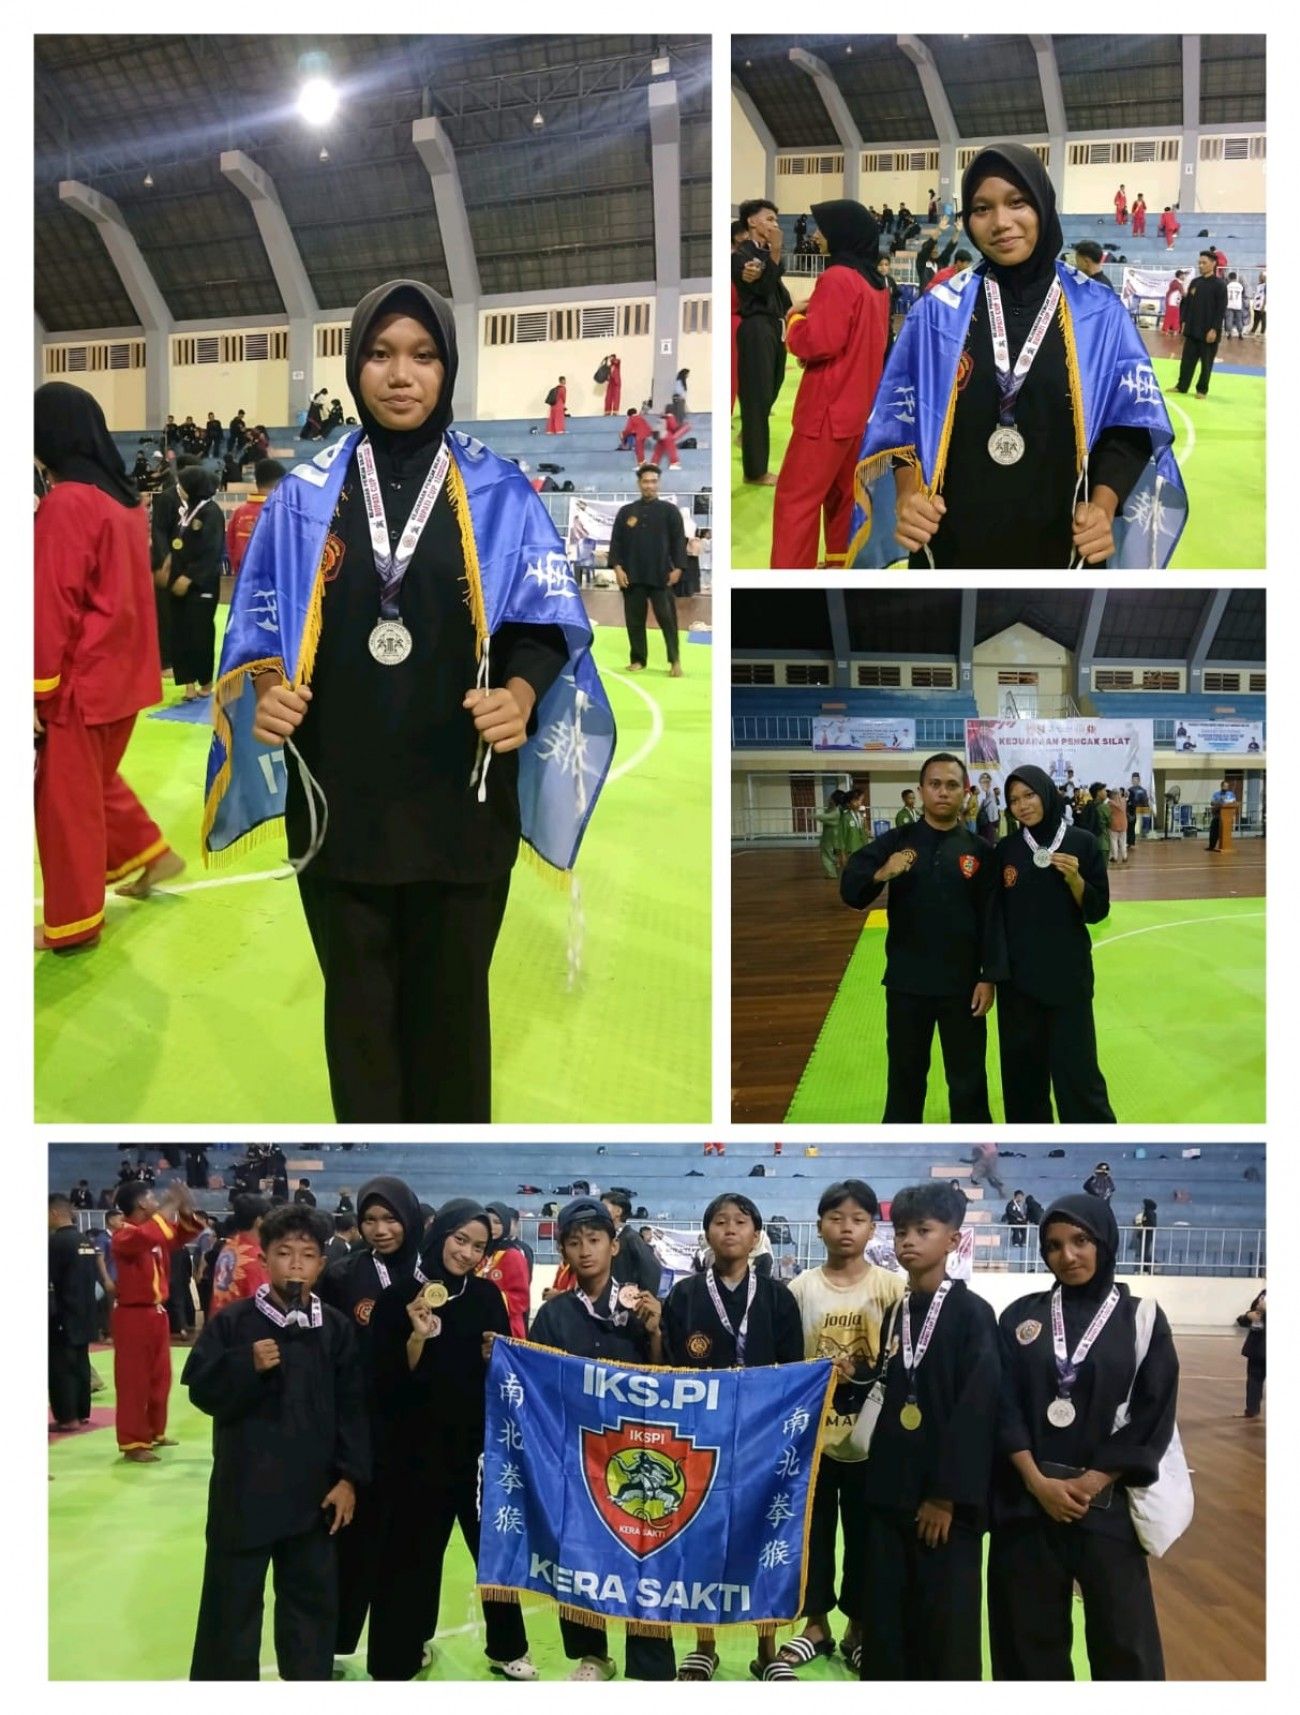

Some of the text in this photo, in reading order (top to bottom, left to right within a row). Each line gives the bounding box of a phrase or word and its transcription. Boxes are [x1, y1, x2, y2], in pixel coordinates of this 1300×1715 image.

[368, 478, 378, 492] CUP
[371, 493, 382, 517] BUPATI
[416, 499, 432, 523] BUPATI
[426, 483, 438, 499] CUP
[999, 737, 1131, 746] KEJUARAN PENCAK SILAT
[823, 1311, 862, 1329] jogja
[583, 1363, 720, 1411] IKS.PI
[629, 1429, 665, 1445] IKSPI
[618, 1524, 666, 1538] KERA SAKTI
[529, 1552, 751, 1613] KERA SAKTI
